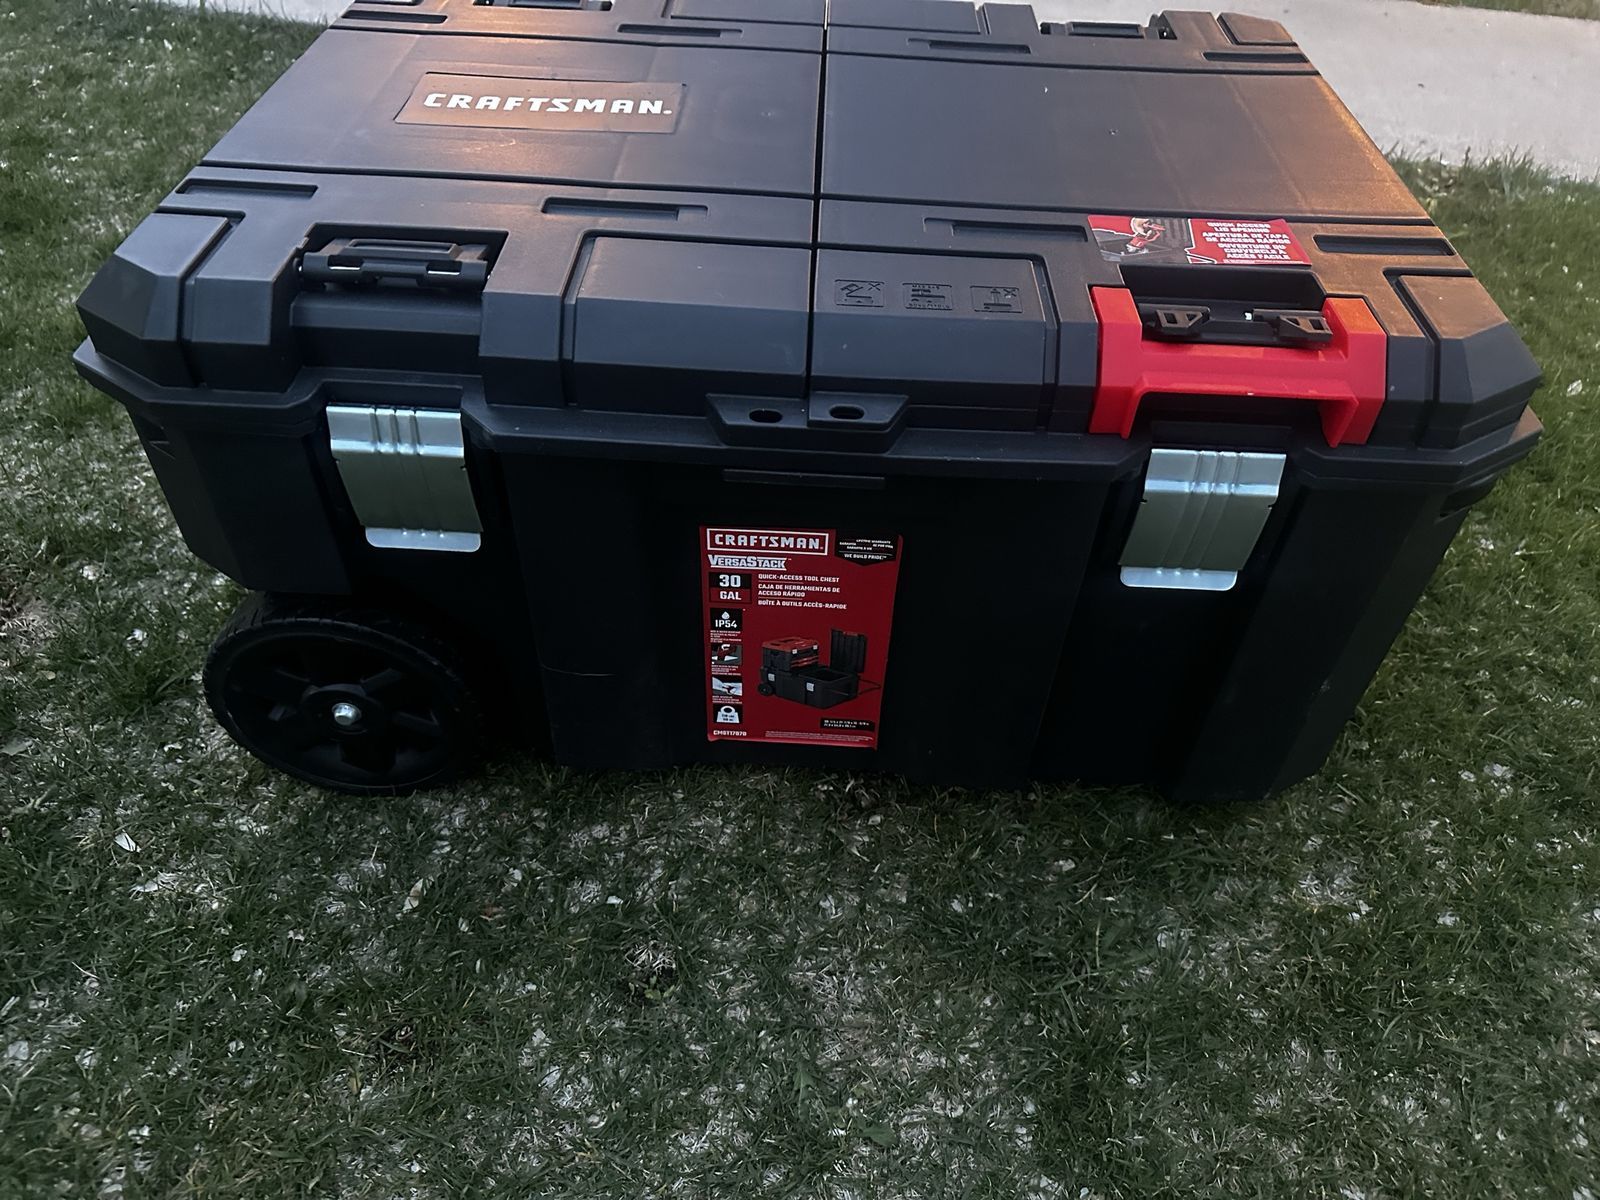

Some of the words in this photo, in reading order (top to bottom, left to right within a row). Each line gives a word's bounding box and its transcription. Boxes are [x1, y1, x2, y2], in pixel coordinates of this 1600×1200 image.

[719, 574, 742, 588] 30
[758, 573, 803, 581] QUICK-ACCESS
[784, 584, 831, 592] HERRAMIENTAS
[719, 591, 742, 601] GAL
[715, 619, 738, 629] IP54
